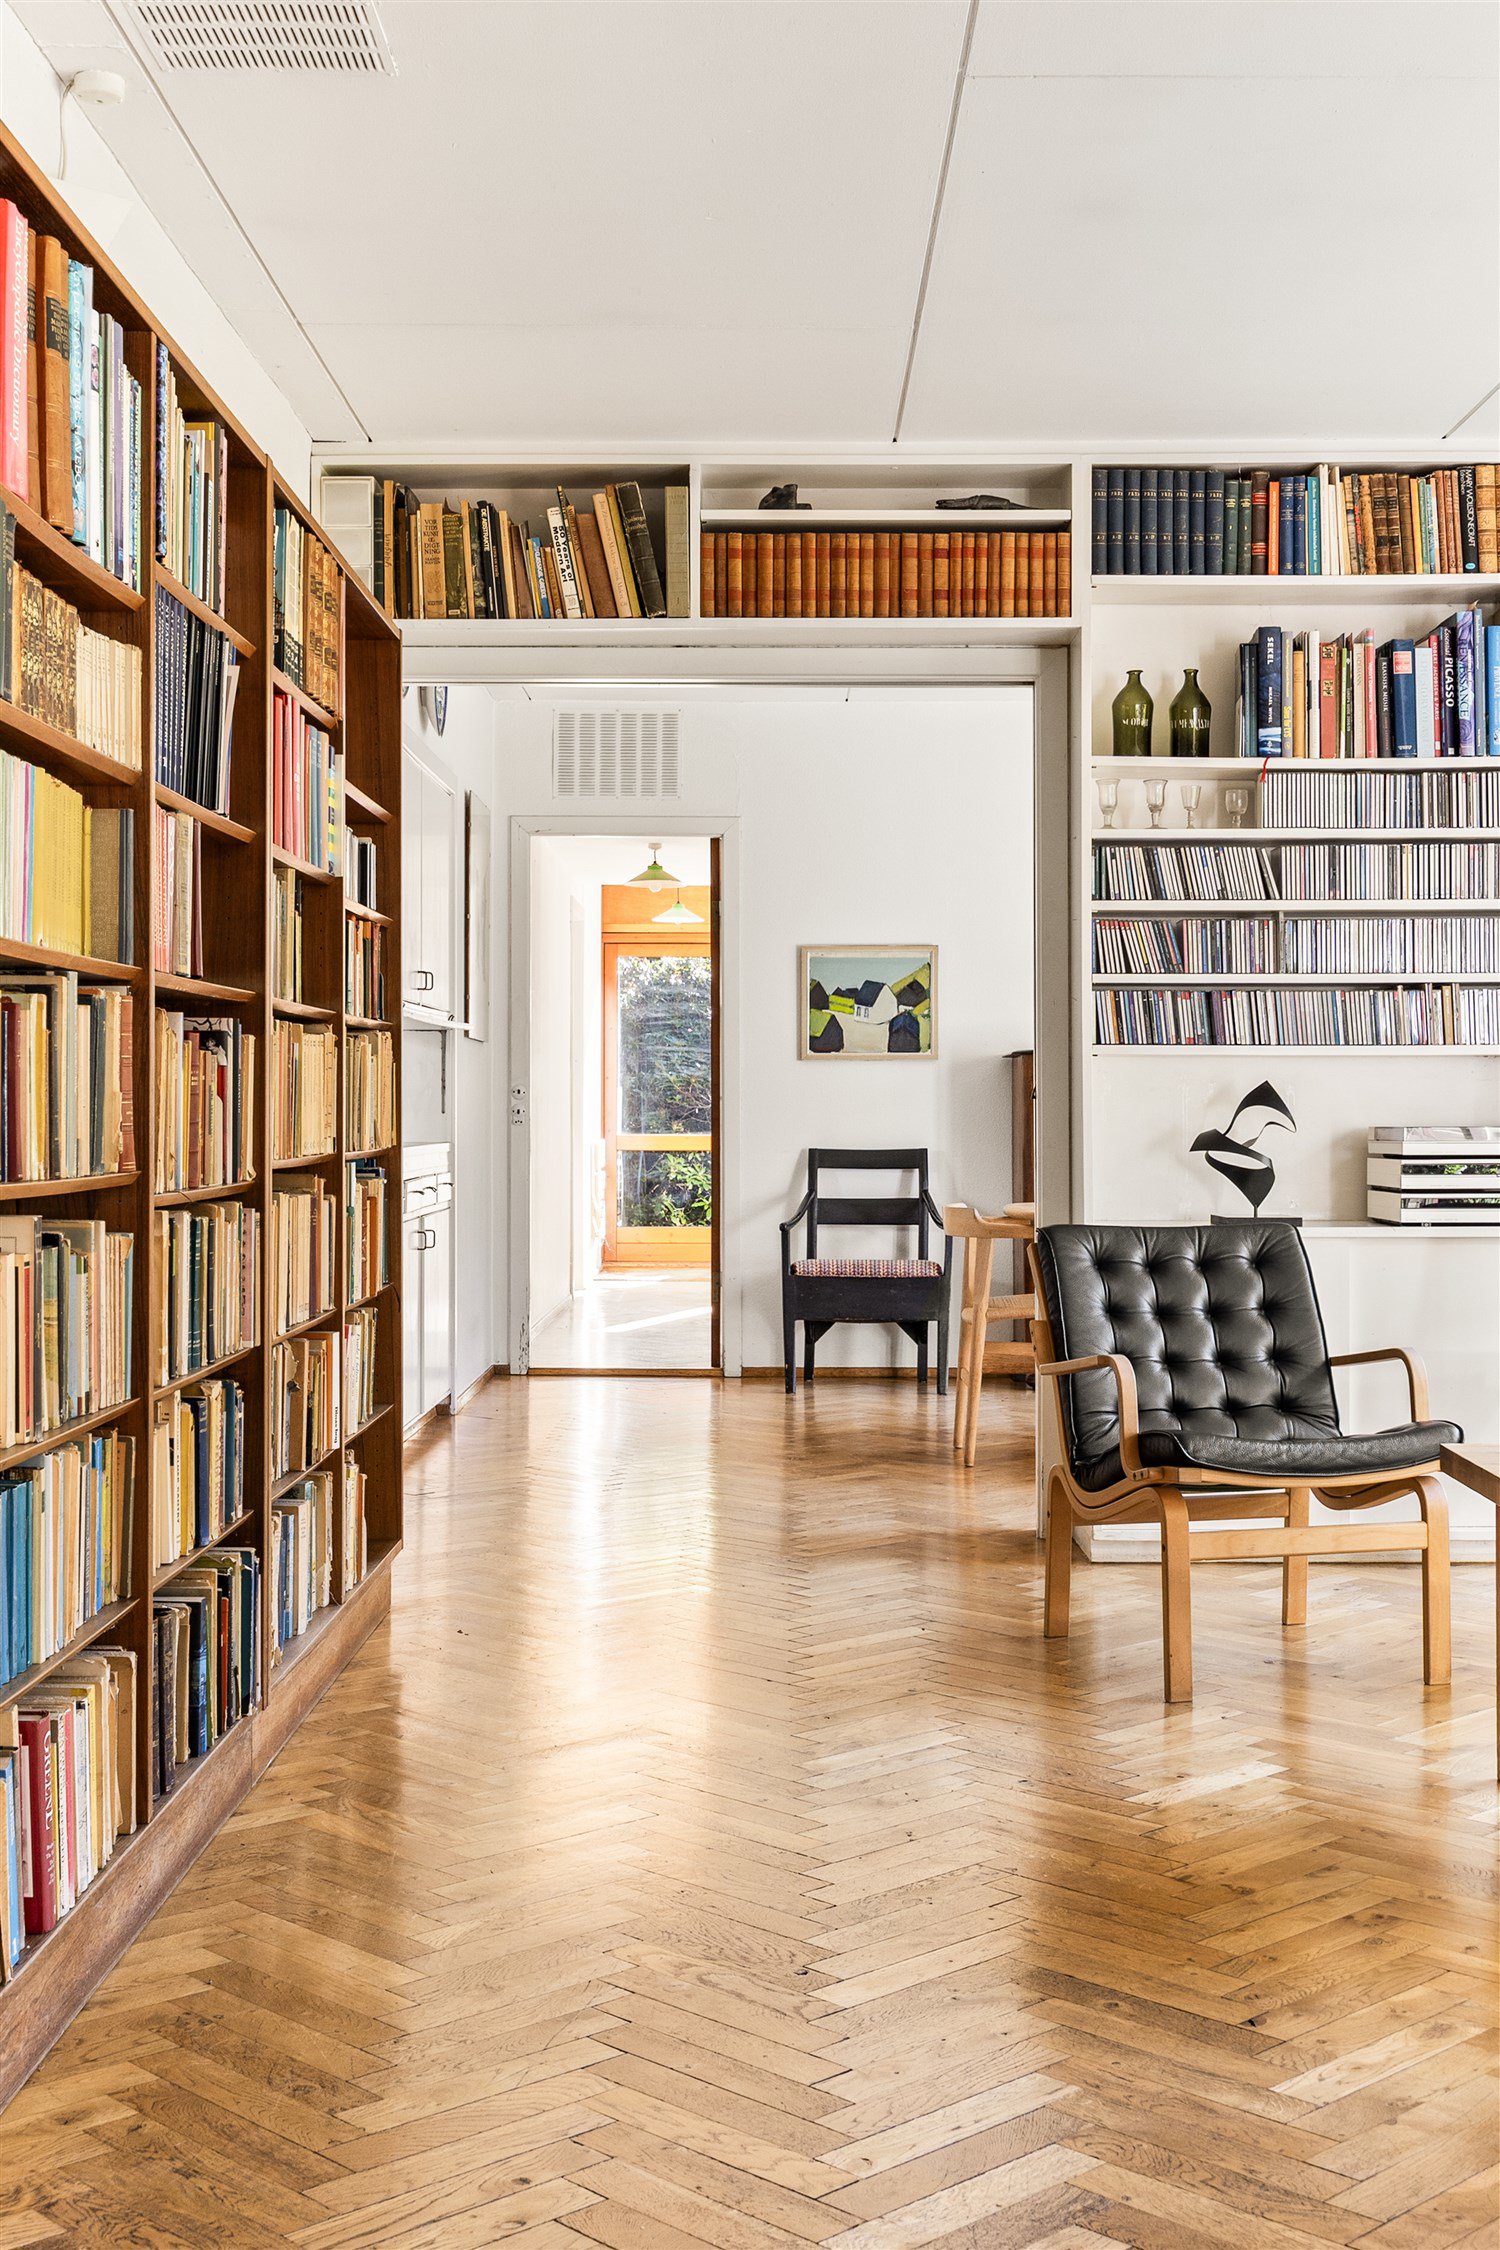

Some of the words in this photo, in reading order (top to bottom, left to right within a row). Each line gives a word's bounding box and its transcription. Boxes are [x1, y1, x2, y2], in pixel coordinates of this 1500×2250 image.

[14, 217, 23, 342] Encyclopedic
[10, 345, 21, 446] Dictionary
[481, 509, 487, 517] DE
[1466, 489, 1475, 546] WOLLSTONECRAFT
[481, 518, 489, 552] ABSTRAKTE
[552, 526, 563, 565] Modern
[558, 525, 565, 538] 50
[561, 540, 571, 570] Years
[567, 573, 574, 582] of
[1444, 628, 1452, 656] Essential
[1445, 657, 1454, 707] PICASSO
[44, 1730, 53, 1830] GREENE
